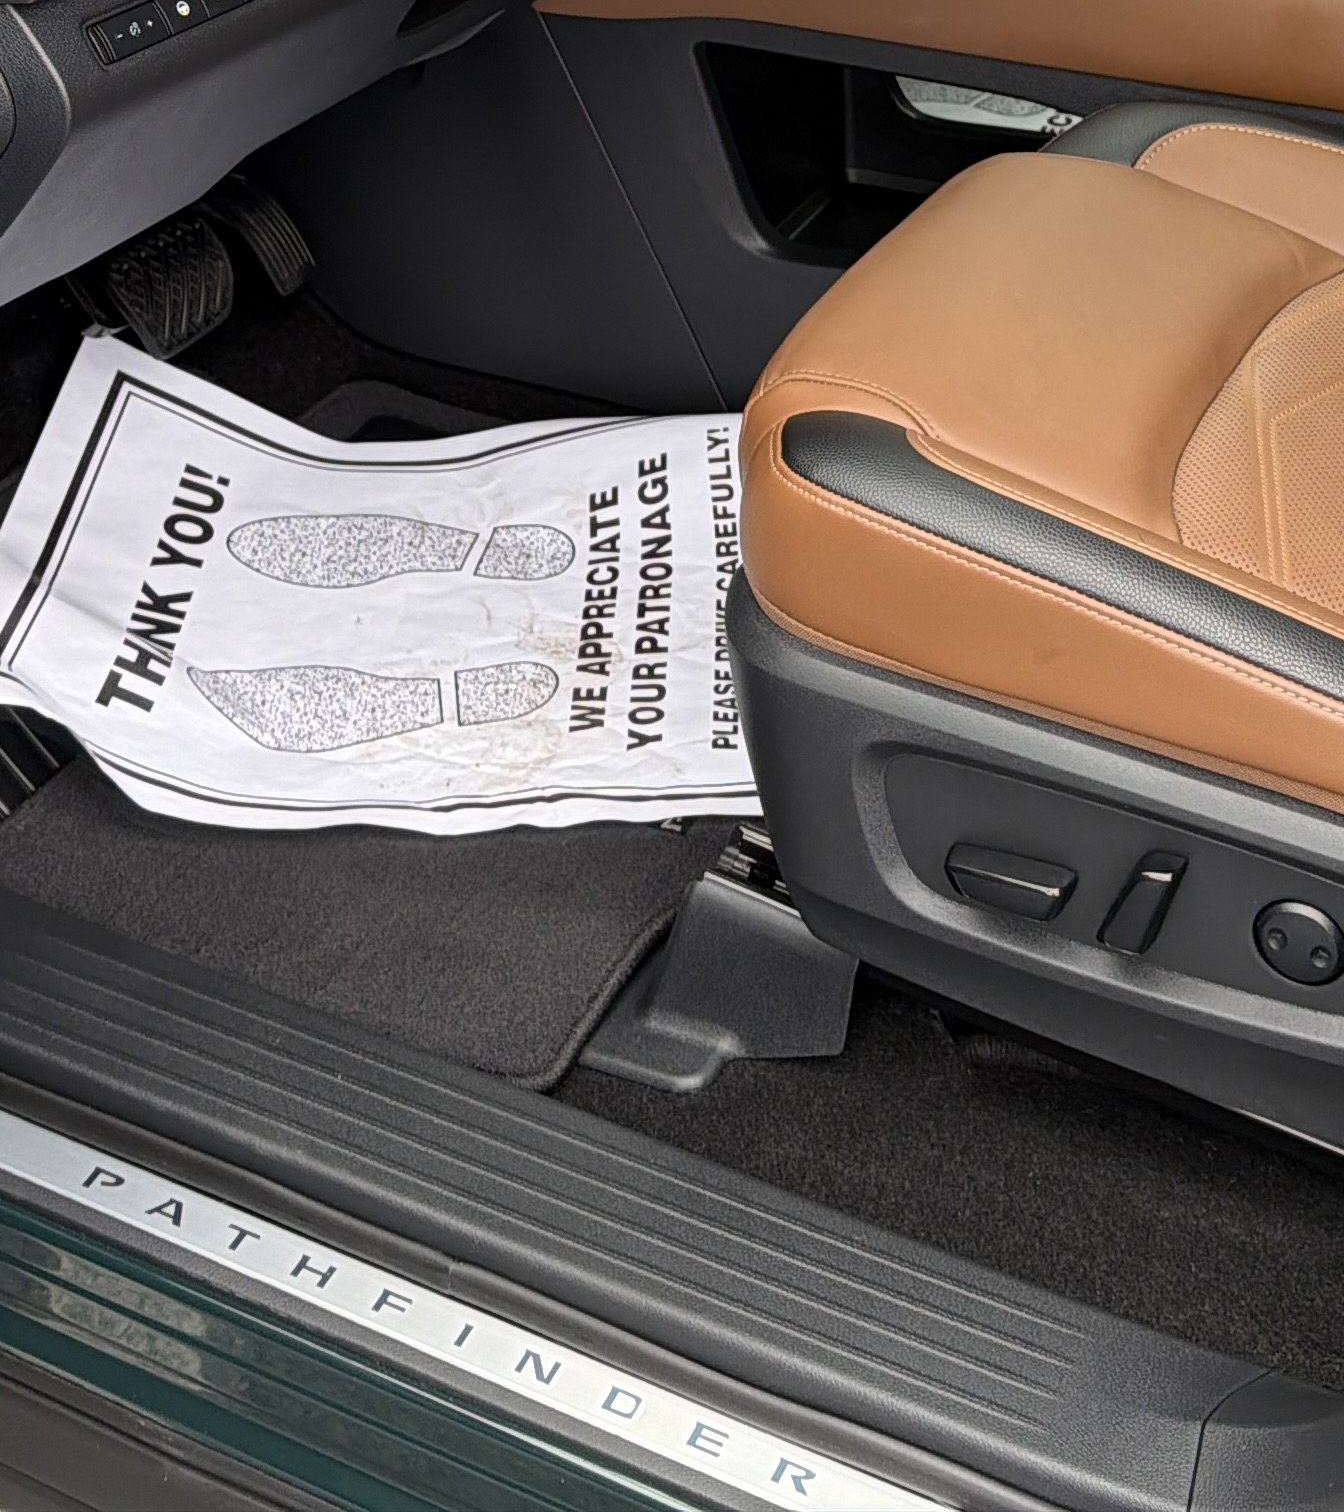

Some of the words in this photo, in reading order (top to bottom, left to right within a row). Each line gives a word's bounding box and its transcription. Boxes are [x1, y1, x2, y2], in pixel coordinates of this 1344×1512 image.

[94, 579, 194, 713] THNK
[149, 462, 231, 569] YOU!
[575, 485, 622, 677] APPRECIATE
[634, 451, 674, 656] PATRONAGE
[706, 426, 739, 592] CAREFULLY!
[568, 684, 608, 734] WE
[626, 661, 669, 752] YOUR
[711, 669, 739, 750] PLEASE
[81, 1165, 817, 1496] PATHFINDER
